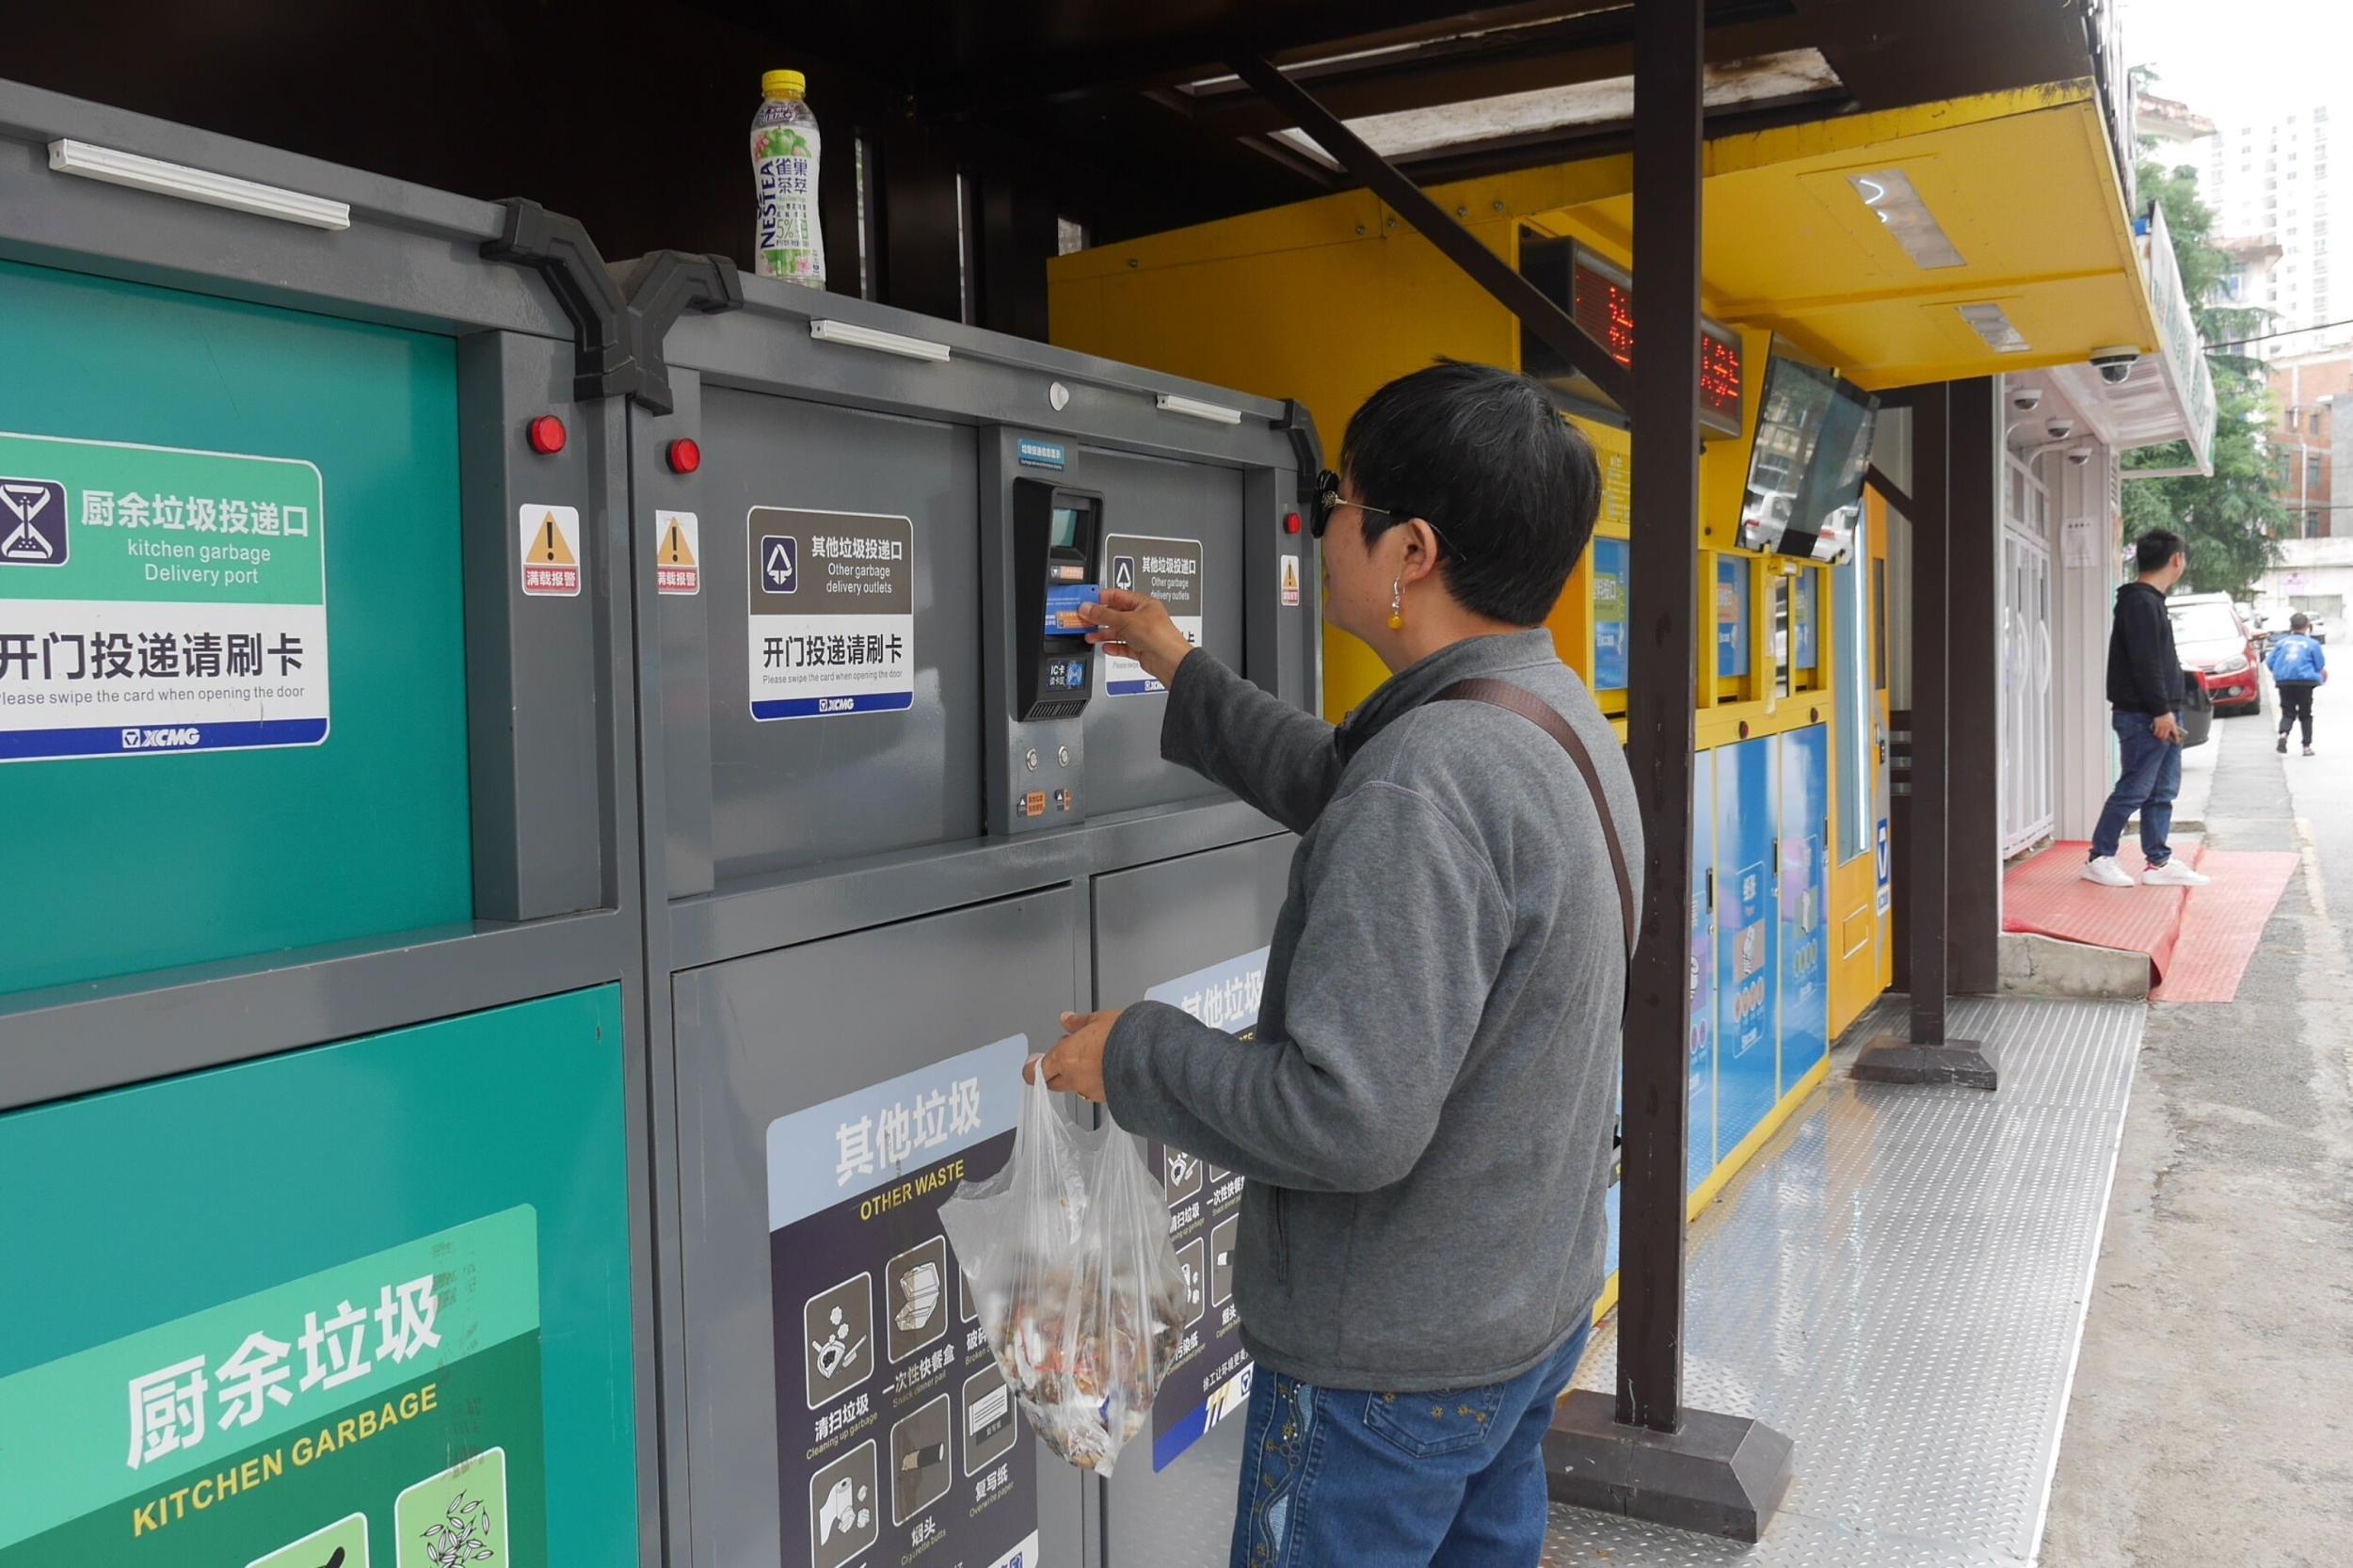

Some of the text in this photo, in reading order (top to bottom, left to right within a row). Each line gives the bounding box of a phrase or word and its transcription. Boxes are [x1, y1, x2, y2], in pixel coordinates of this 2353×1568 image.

[776, 158, 808, 176] 雀巢
[81, 489, 309, 537] 厨余垃圾投递口
[127, 538, 271, 563] kitchen garbage
[811, 536, 903, 561] 其他垃圾投递口
[145, 564, 259, 586] Delivery port
[526, 570, 576, 587] 满载报警
[828, 563, 890, 580] Other garbage
[1151, 577, 1166, 587] Other
[826, 580, 892, 596] delivery outlets
[0, 632, 303, 680] 开门投递请刷卡
[763, 634, 903, 668] 开门投递请刷卡
[763, 673, 787, 684] Please
[788, 673, 808, 685] swipe
[808, 671, 819, 682] the
[820, 671, 835, 681] card
[0, 685, 305, 707] lease swipe the card when opening the door
[141, 728, 200, 747] XCMG
[836, 1076, 982, 1188] 其他垃圾
[860, 1160, 965, 1221] OTHER WASTE
[126, 1274, 442, 1470] 厨余垃圾
[883, 1344, 955, 1394] 一次性快餐盒
[814, 1392, 870, 1442] 清扫垃圾
[806, 1411, 878, 1461] Cleaning up garbage
[132, 1384, 439, 1537] KITCHEN GARBAGE
[976, 1463, 1008, 1502] 复写纸
[911, 1515, 936, 1547] 烟头
